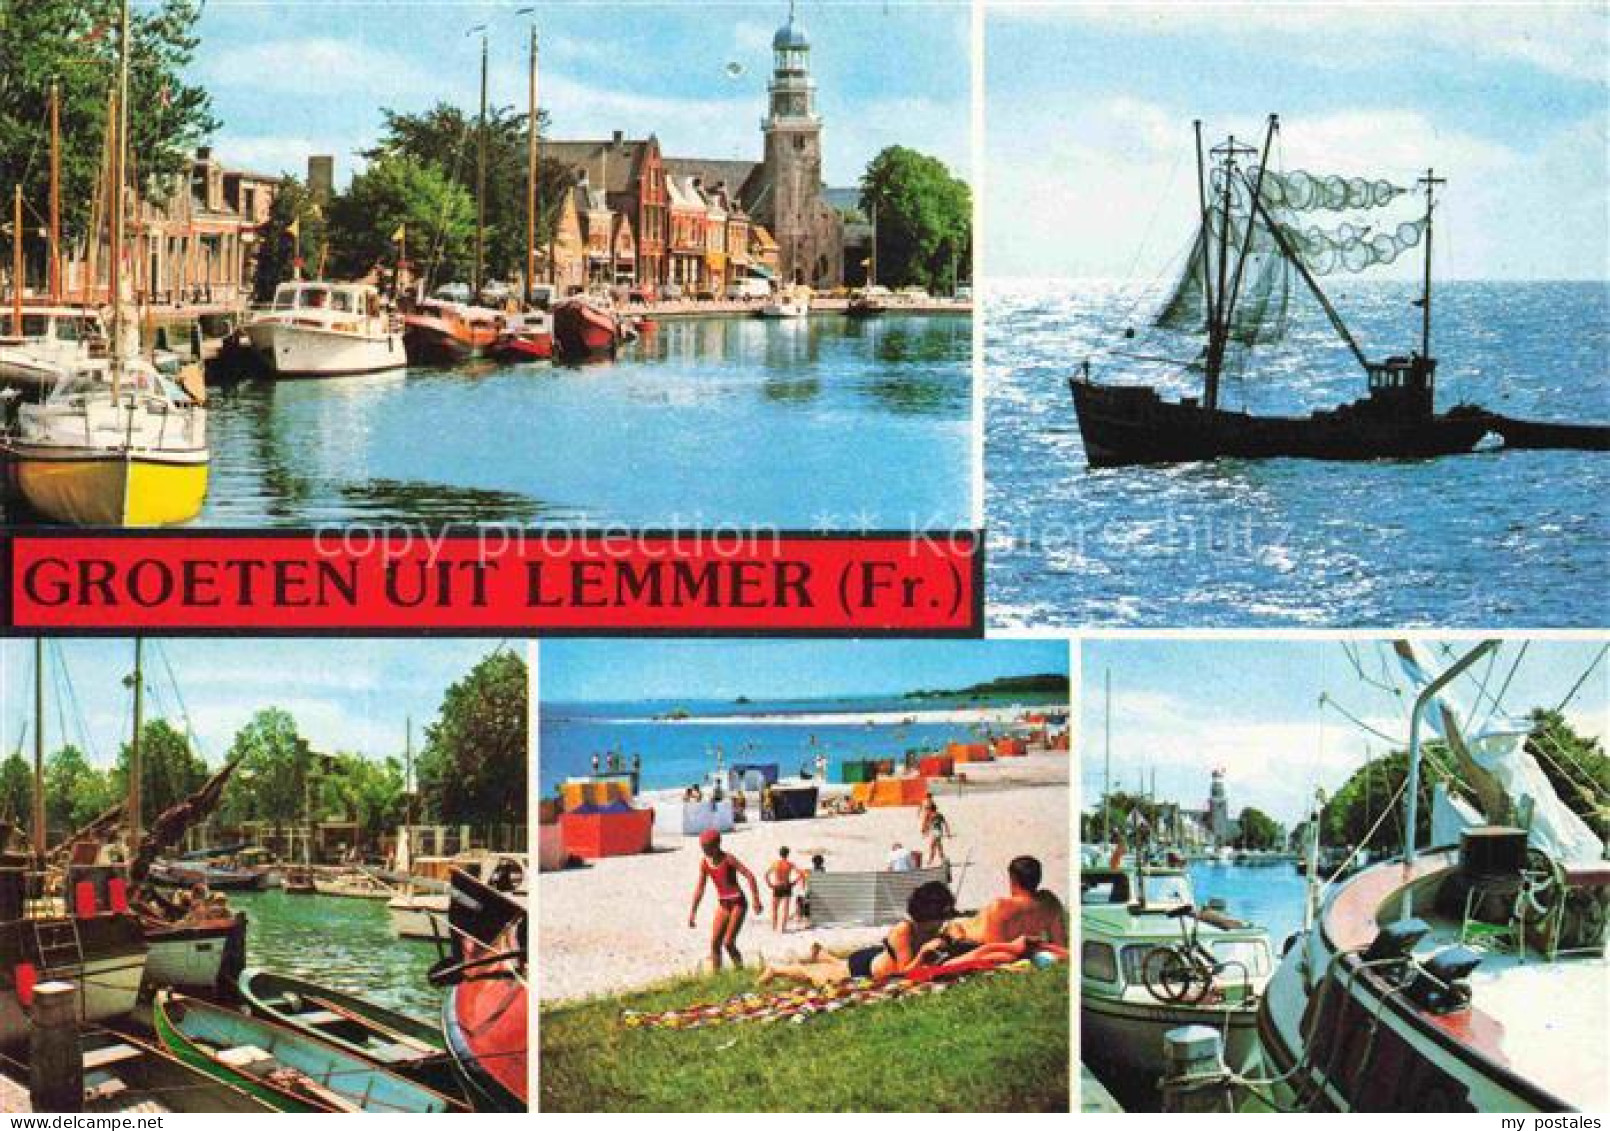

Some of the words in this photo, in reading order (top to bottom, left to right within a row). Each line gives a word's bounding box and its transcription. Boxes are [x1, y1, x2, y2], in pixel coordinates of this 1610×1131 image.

[23, 557, 359, 608] GROETEN
[385, 560, 499, 608] UIT
[525, 560, 815, 608] LEMMER
[839, 560, 963, 617] (Fr.)
